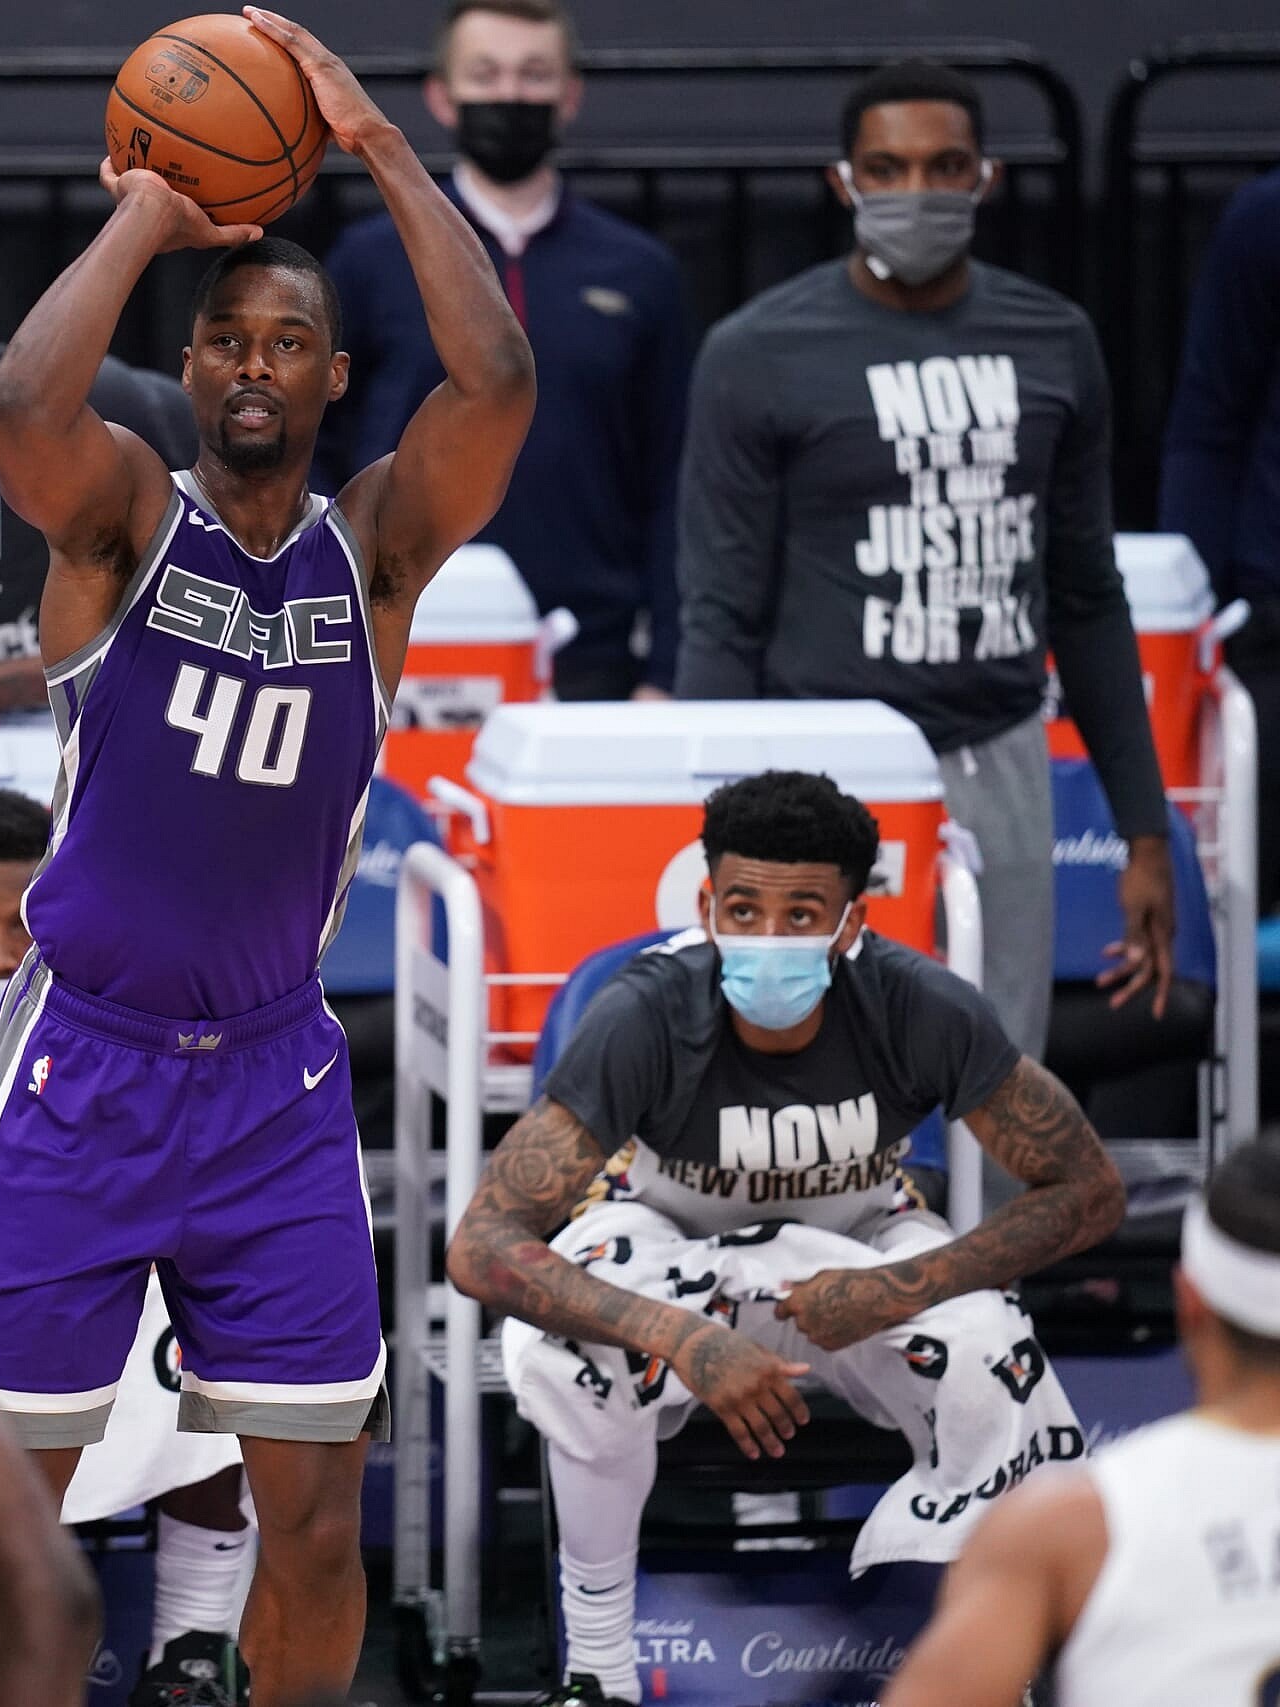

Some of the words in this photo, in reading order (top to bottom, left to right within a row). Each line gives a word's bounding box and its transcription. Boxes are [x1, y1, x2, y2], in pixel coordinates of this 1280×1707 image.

[866, 355, 1021, 441] NOW
[928, 432, 963, 470] THE
[968, 427, 1018, 467] TIME
[946, 465, 1005, 503] MAKE
[854, 493, 1036, 577] JUSTICE
[146, 564, 352, 670] SAC
[863, 595, 960, 664] FOR
[164, 660, 313, 787] 40
[719, 1091, 879, 1172] NOW
[657, 1157, 739, 1198] NEW
[747, 1147, 898, 1204] ORLEANS
[633, 1638, 717, 1664] LTRA
